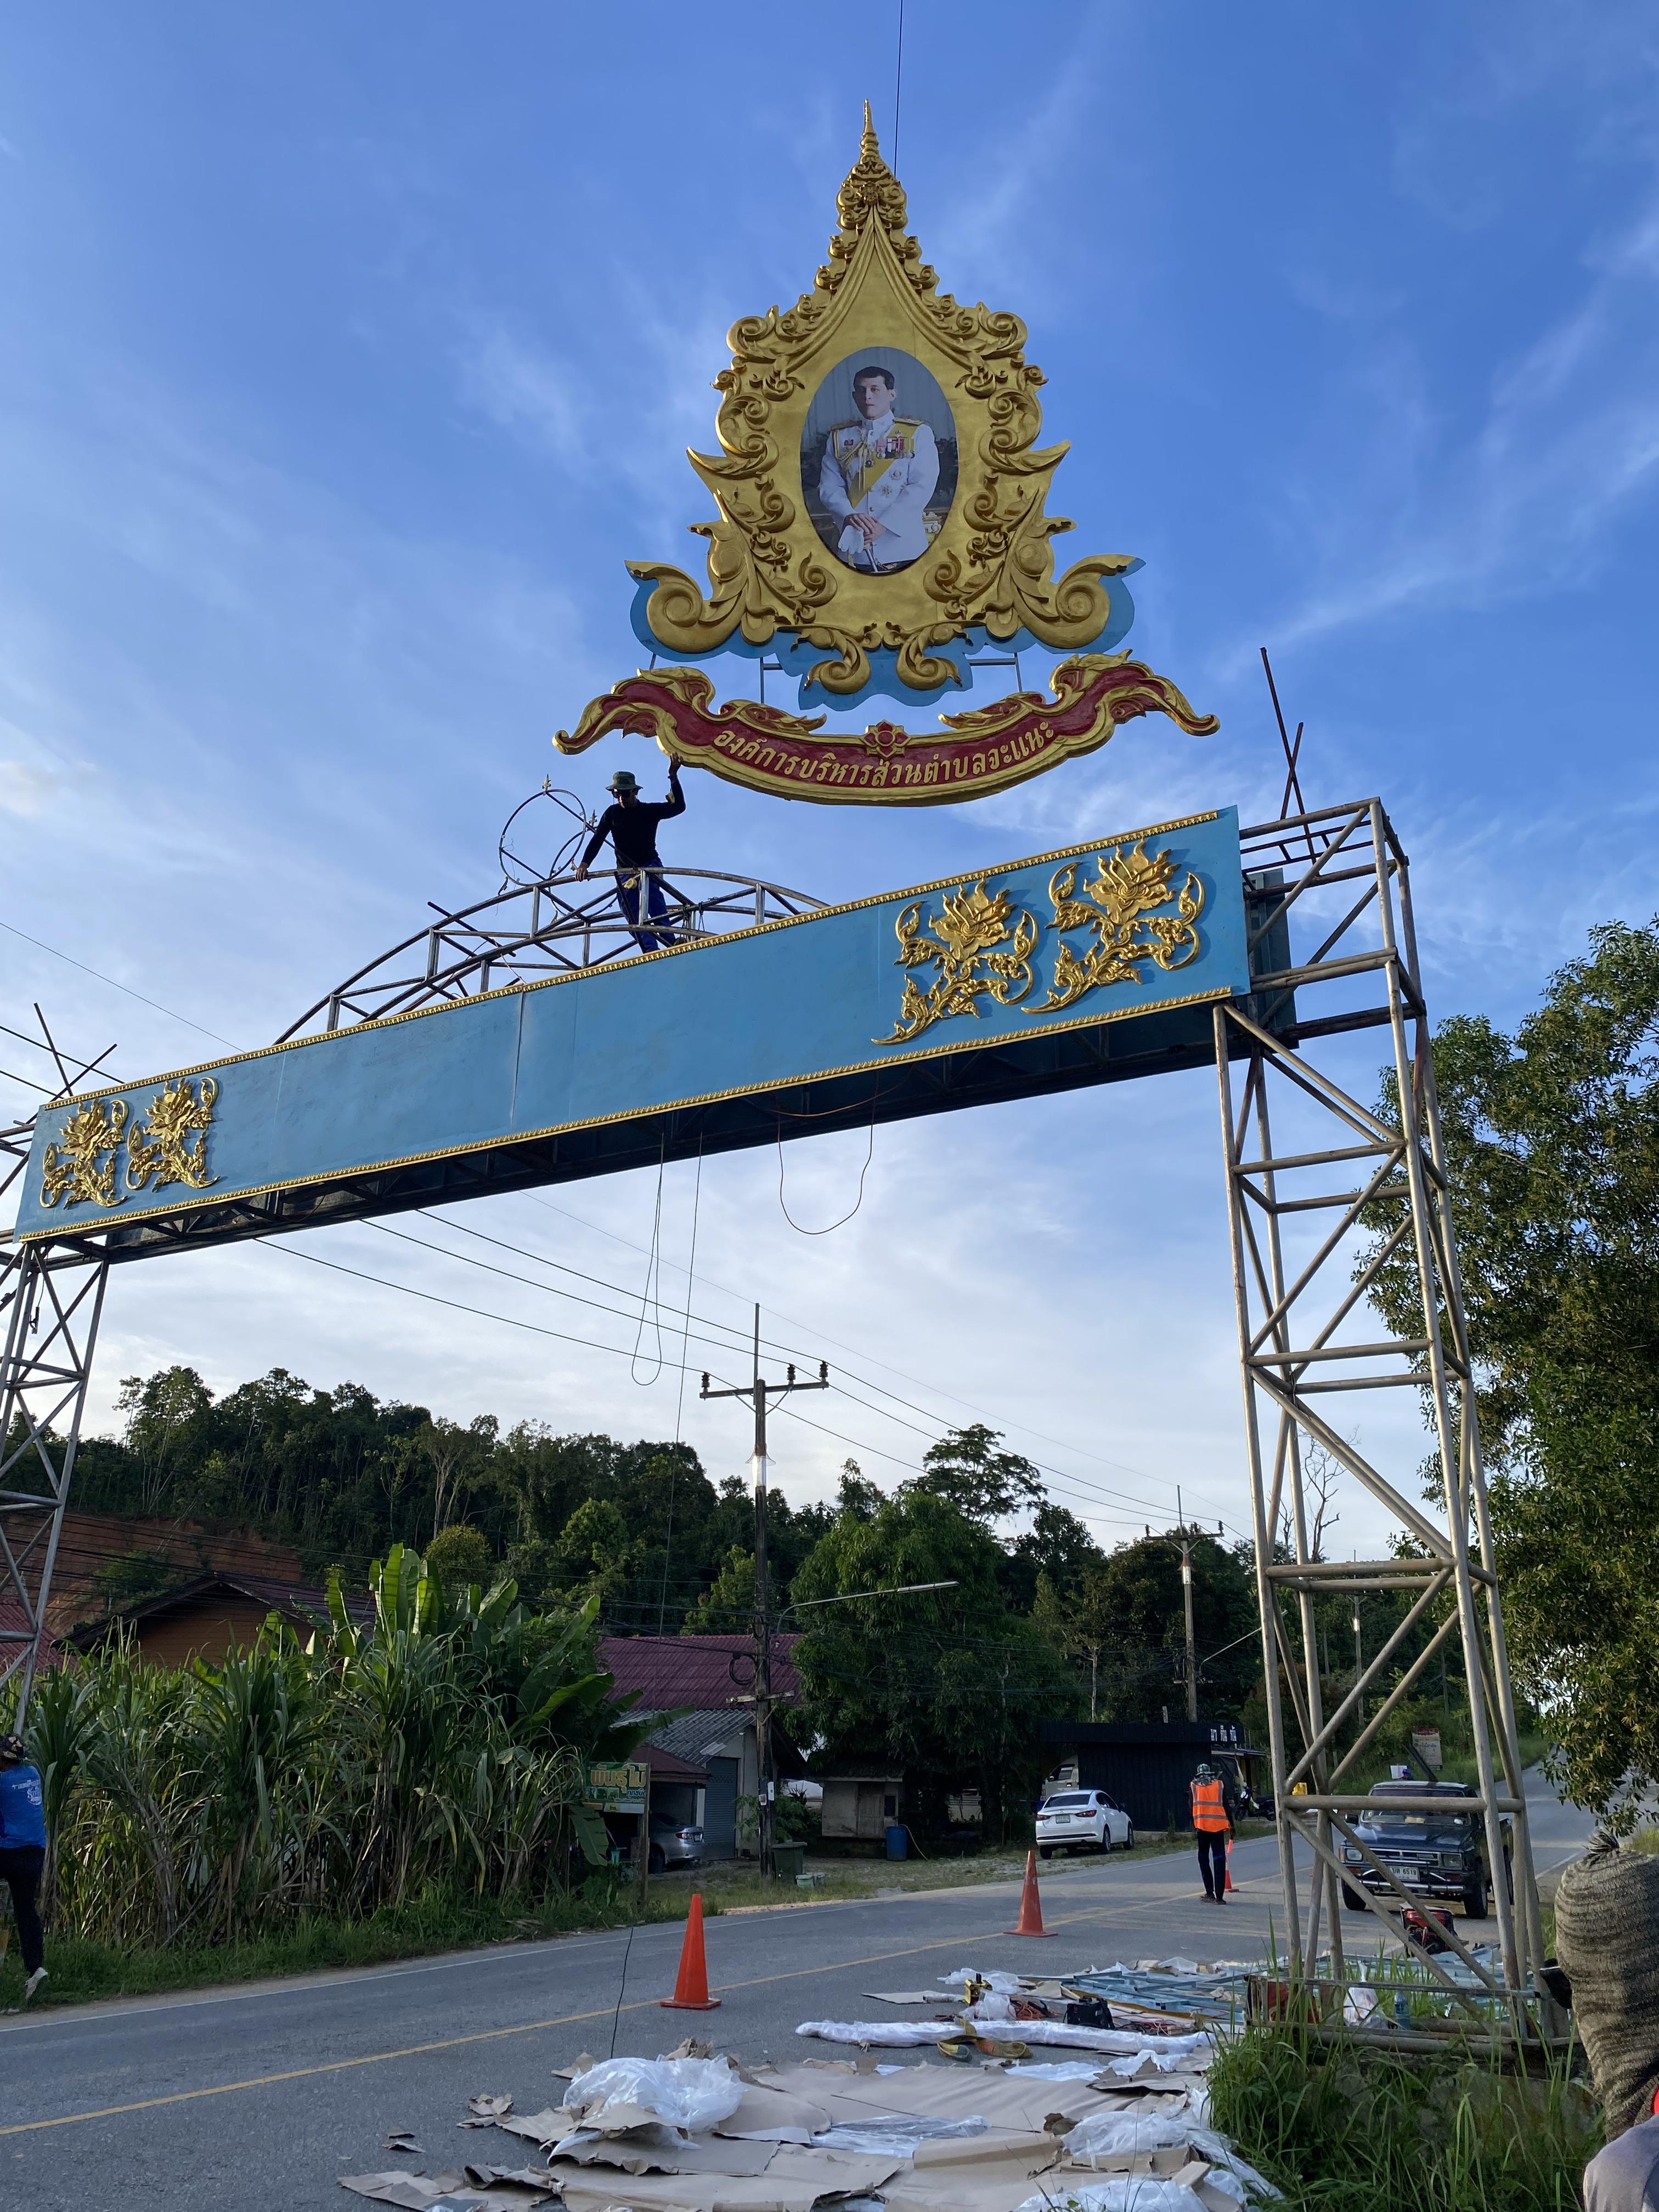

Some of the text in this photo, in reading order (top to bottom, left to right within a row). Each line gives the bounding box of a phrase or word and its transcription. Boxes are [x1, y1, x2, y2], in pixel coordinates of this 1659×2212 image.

[713, 721, 1054, 786] องค์การบริหารส่วนตำบลจะแนะ
